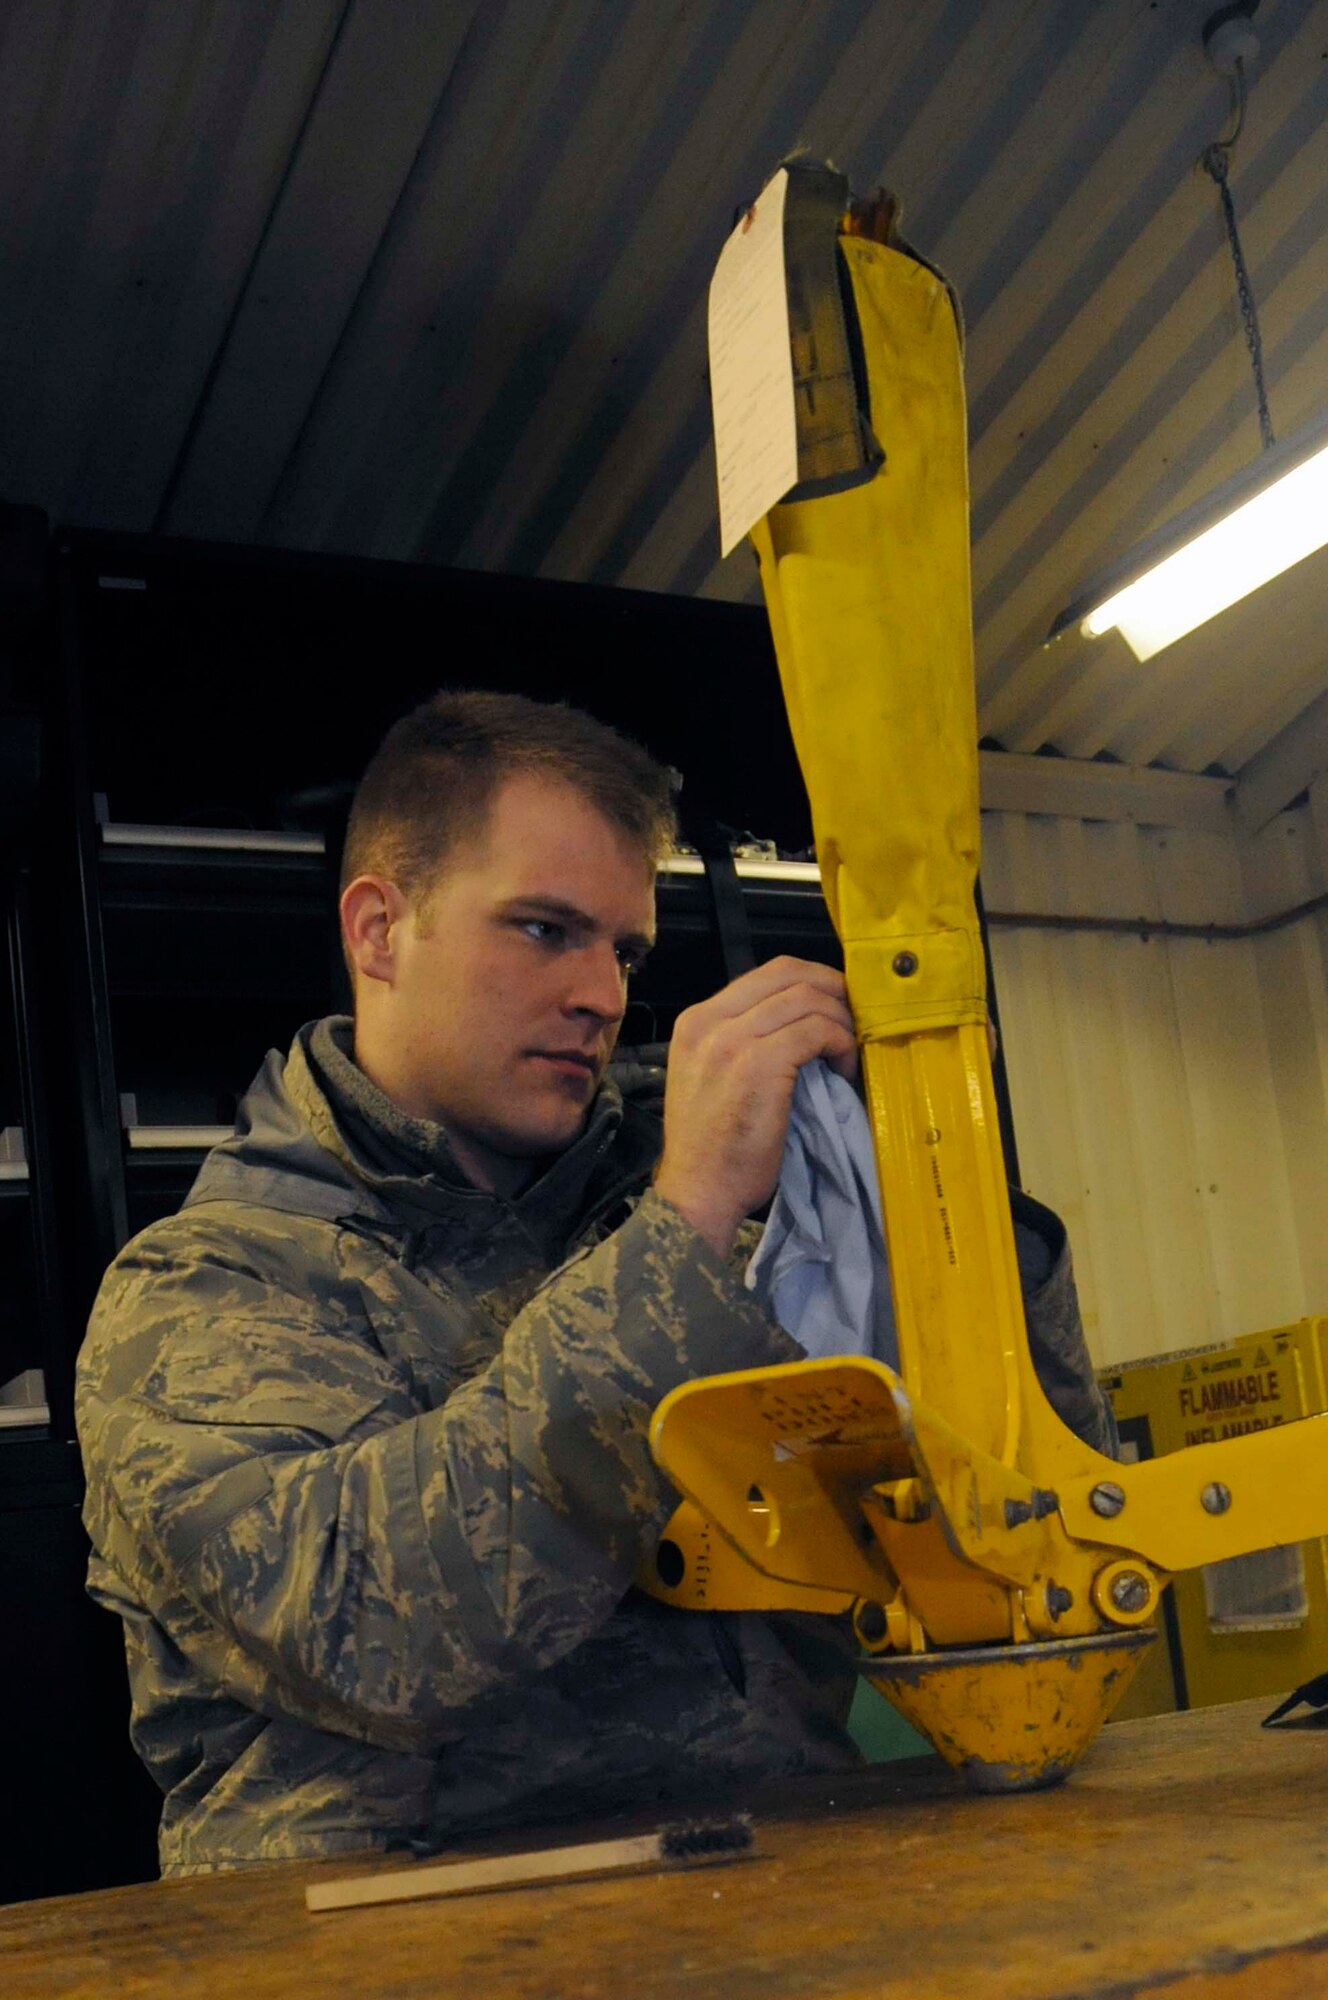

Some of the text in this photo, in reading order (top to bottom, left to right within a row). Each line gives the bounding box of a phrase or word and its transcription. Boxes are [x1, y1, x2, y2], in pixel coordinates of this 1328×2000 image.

[1121, 1353, 1170, 1371] STORAGE
[1173, 1344, 1217, 1361] LOCKER
[1179, 1371, 1280, 1416] FLAMMABLE
